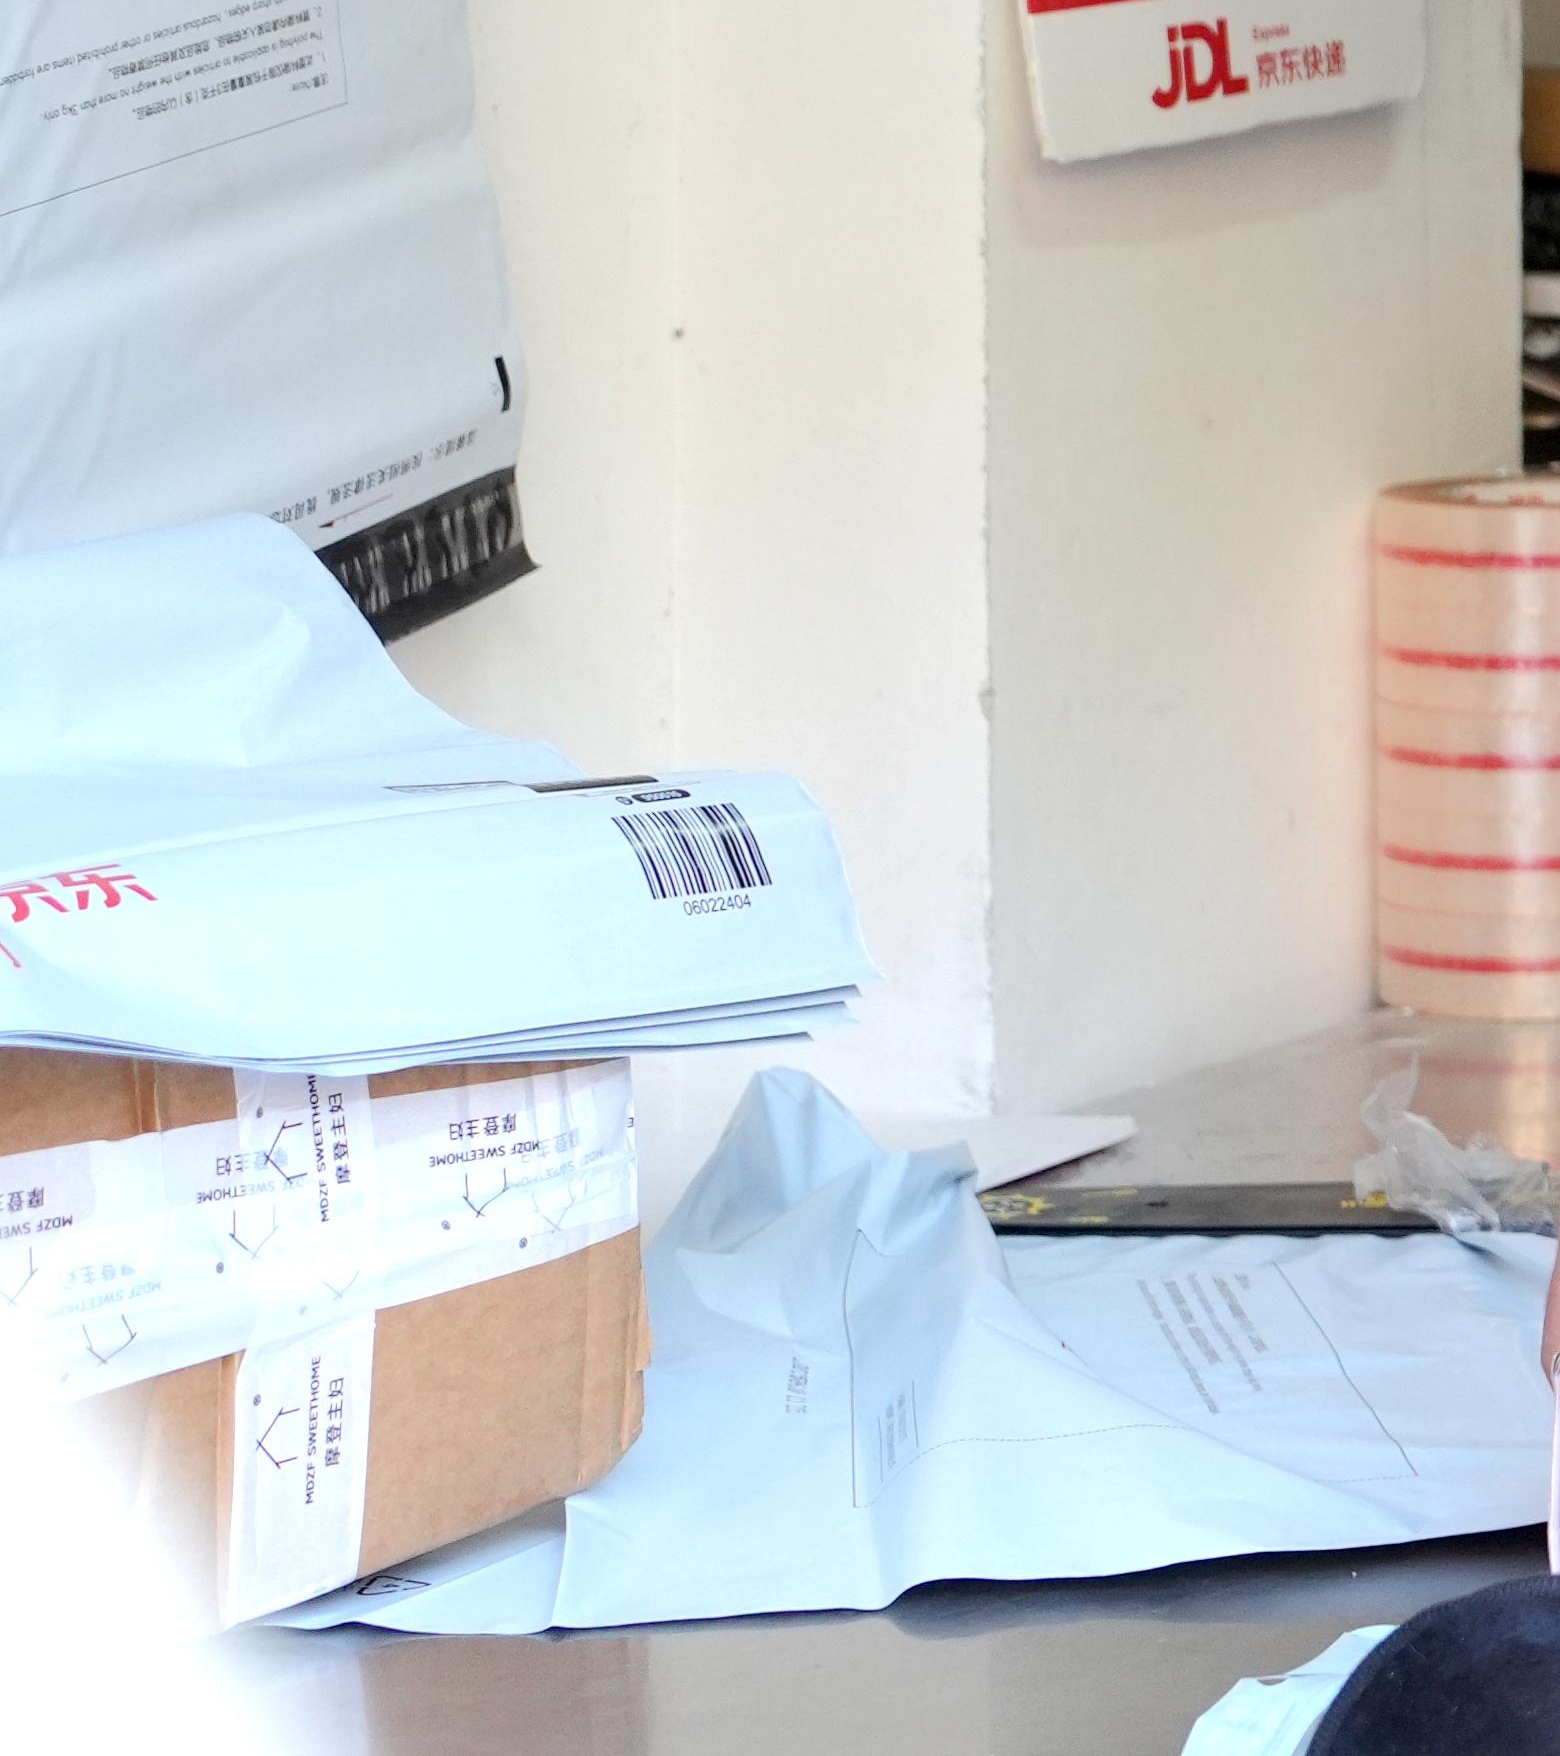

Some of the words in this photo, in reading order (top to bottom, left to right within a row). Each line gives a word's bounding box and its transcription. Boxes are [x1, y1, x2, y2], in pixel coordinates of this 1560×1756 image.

[1152, 16, 1249, 108] JDL
[1255, 40, 1345, 88] 京东快递
[683, 893, 752, 917] 06022404
[328, 1092, 352, 1185] 摩登主妇
[449, 1112, 517, 1141] 摩登主妇
[509, 1139, 541, 1155] MDZF
[429, 1144, 506, 1168] SWEETHOME
[318, 1179, 331, 1223] MDZF
[37, 1214, 73, 1232] MDZF
[307, 1356, 321, 1457] SWEETHOME
[325, 1377, 344, 1467] 摩登主妇
[305, 1462, 316, 1505] MDZF
